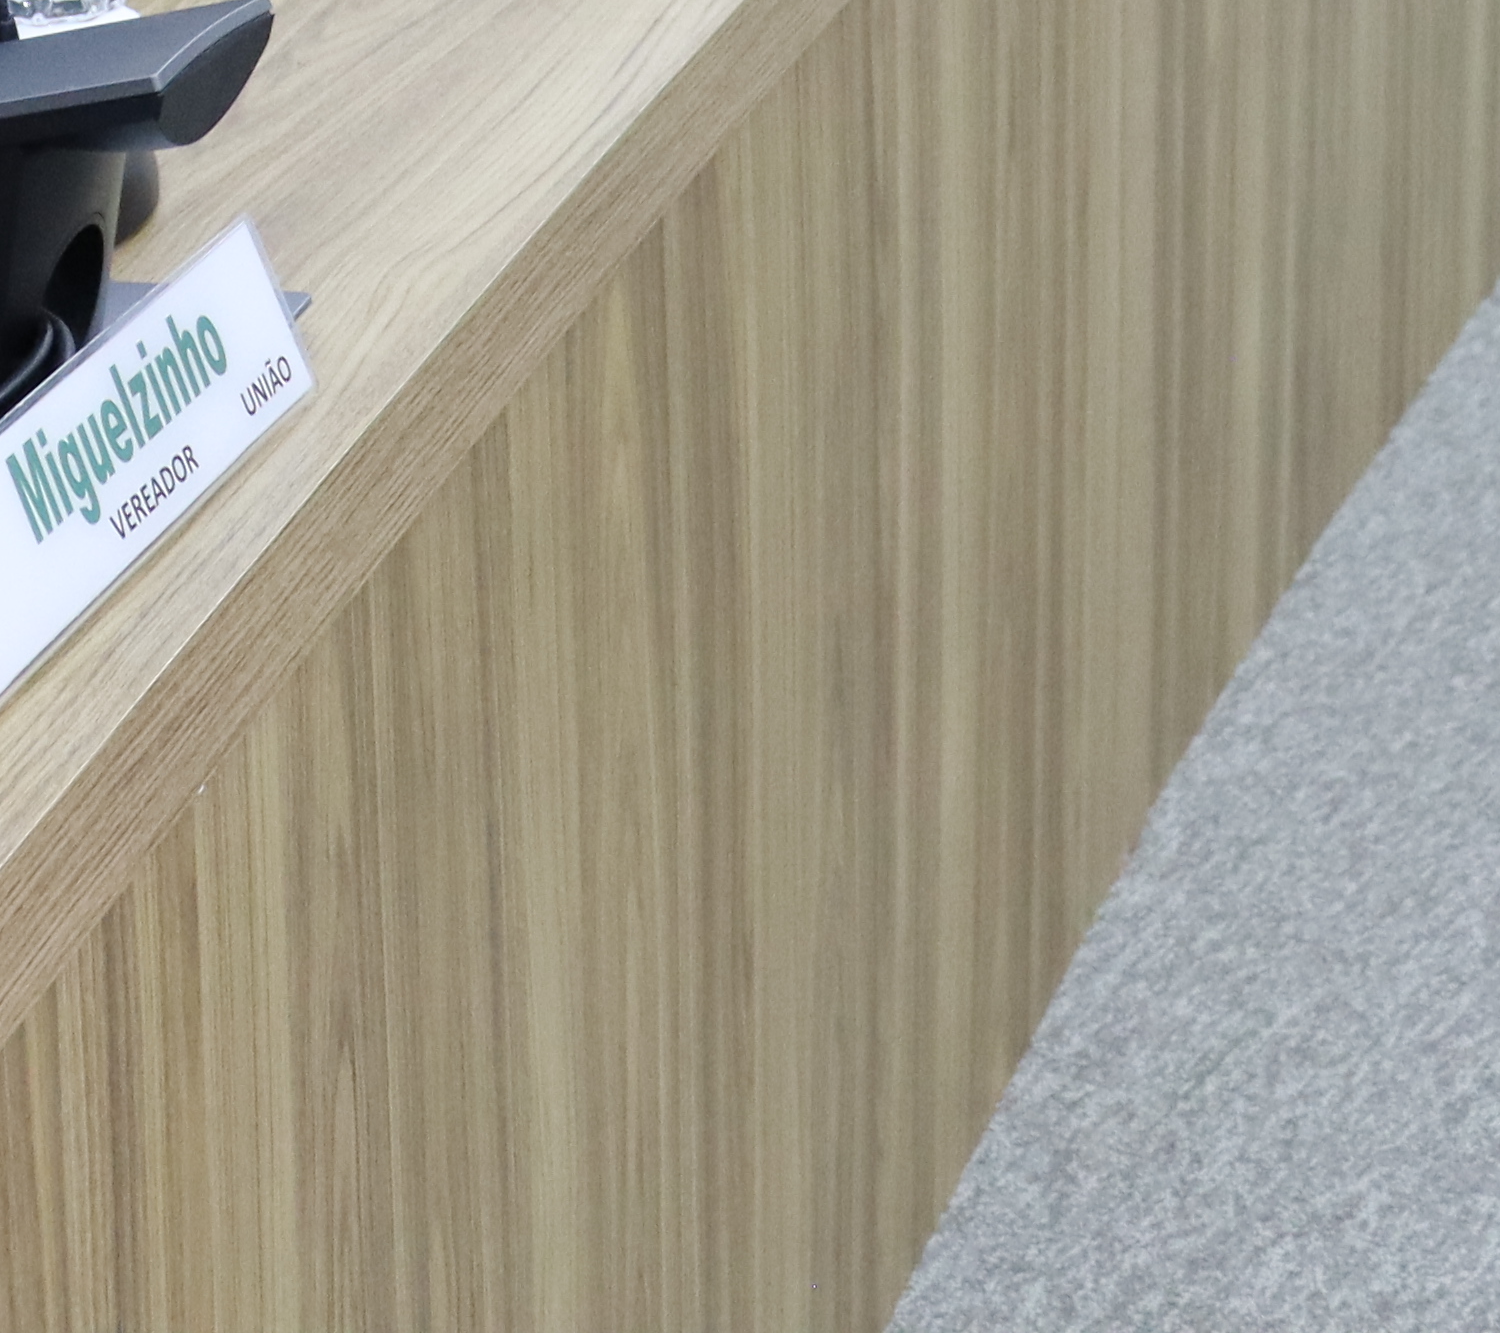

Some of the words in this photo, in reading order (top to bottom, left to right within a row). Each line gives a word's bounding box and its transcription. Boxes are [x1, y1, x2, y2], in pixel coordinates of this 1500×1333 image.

[6, 313, 229, 545] Miguelzinho
[108, 444, 200, 540] VEREADOR
[239, 355, 293, 416] UNIÃO
